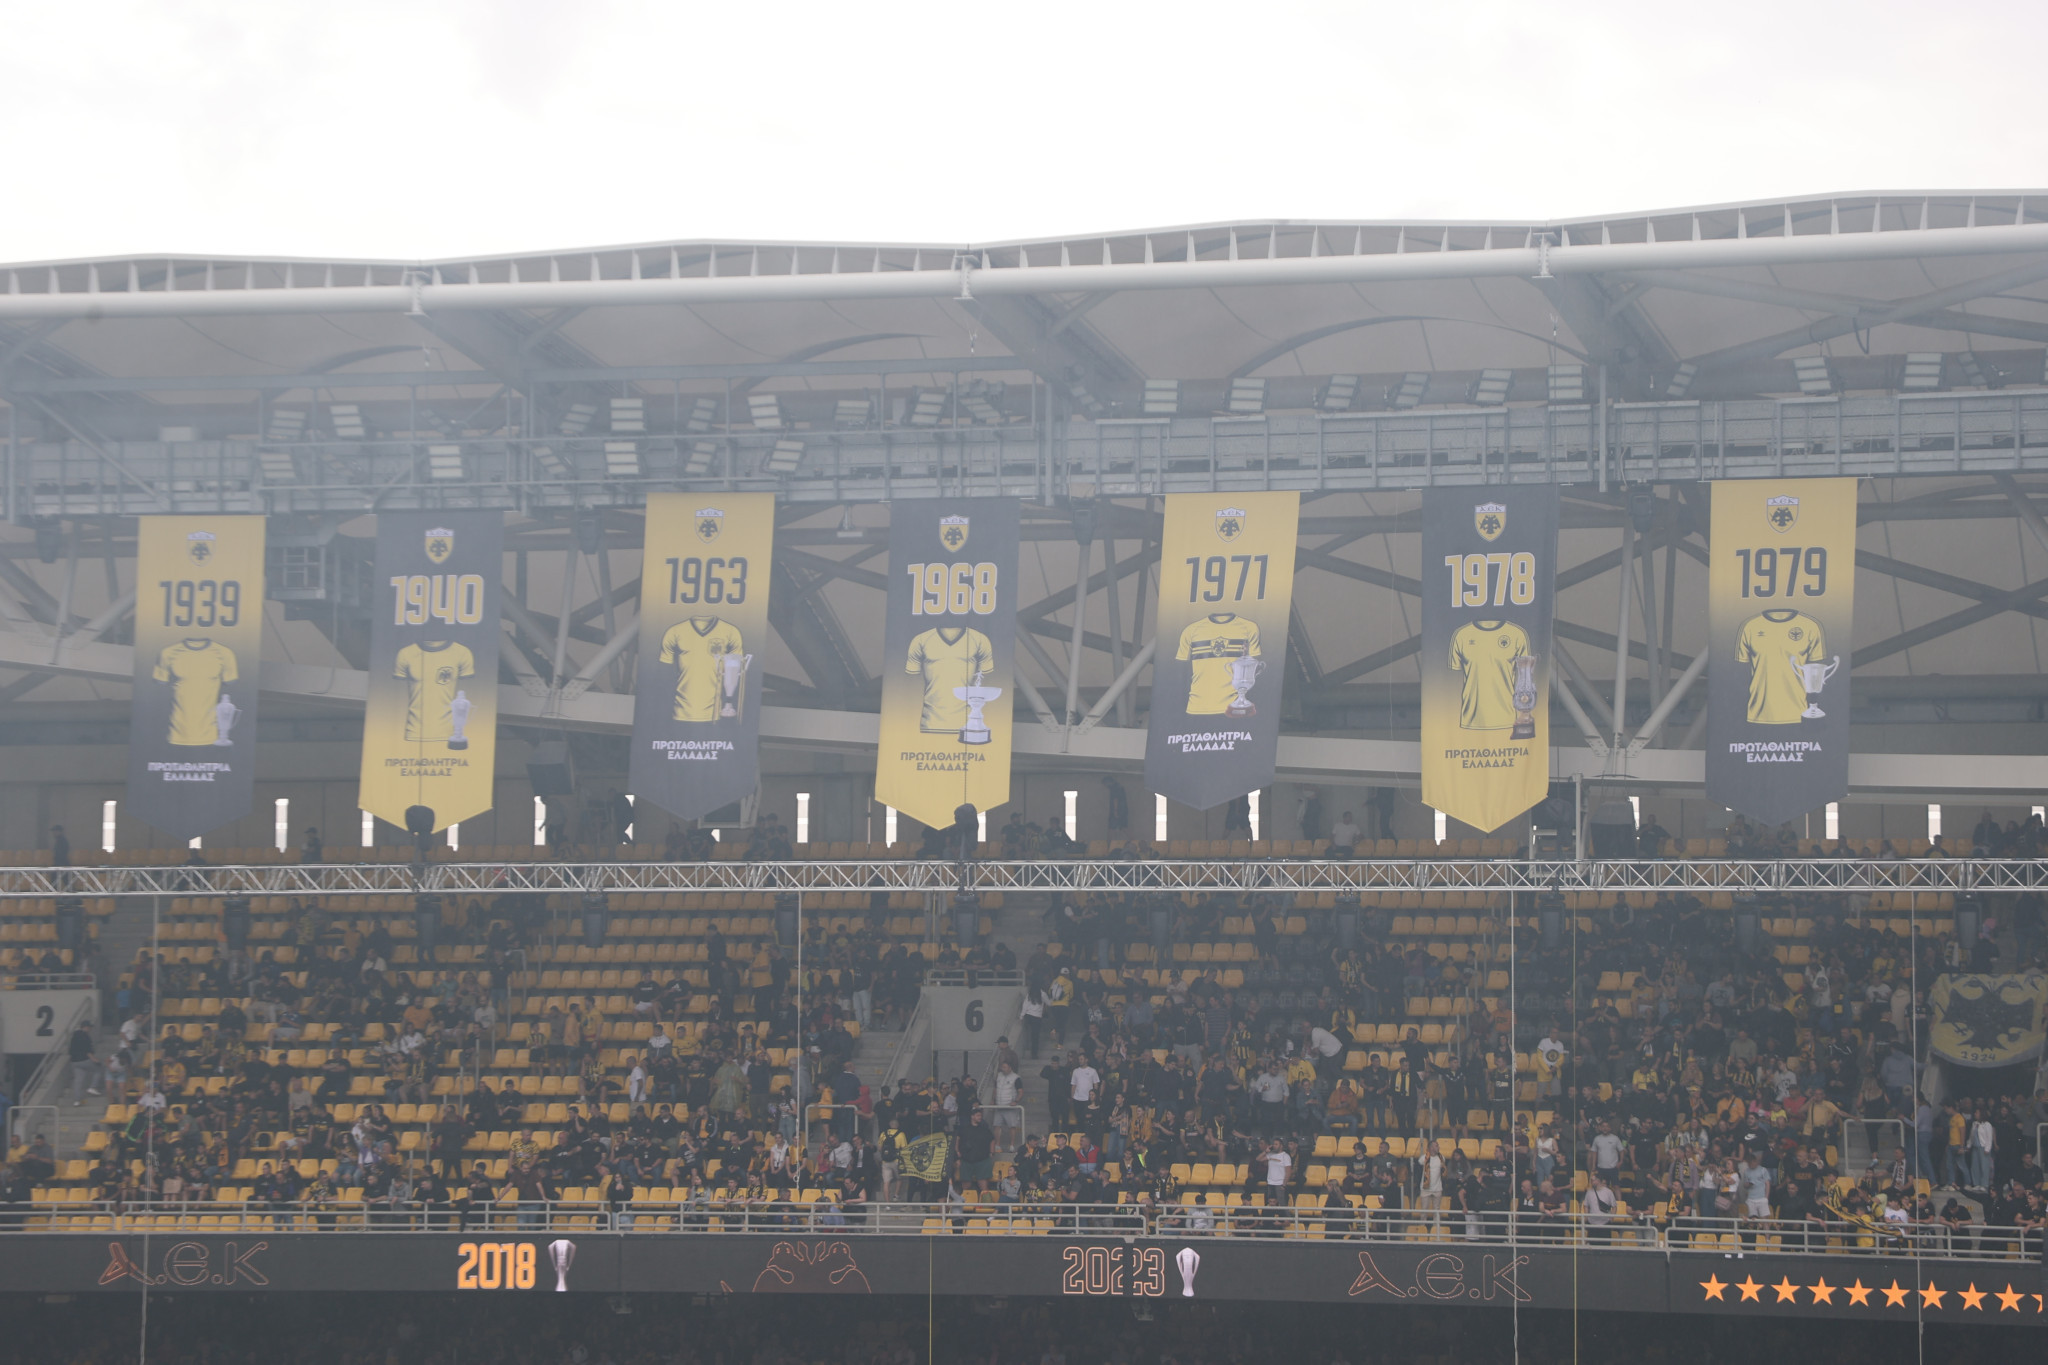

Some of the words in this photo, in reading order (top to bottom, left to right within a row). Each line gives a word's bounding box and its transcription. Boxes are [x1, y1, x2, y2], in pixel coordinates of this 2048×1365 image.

[665, 556, 748, 605] 1963
[1186, 554, 1268, 603] 1971
[1445, 551, 1536, 607] 1978
[1736, 546, 1828, 598] 1979
[158, 580, 241, 627] 1939
[390, 574, 484, 625] 1940
[907, 562, 998, 615] 1968
[652, 740, 734, 750] ΠΡΩΤΑΘΛΗΤΡΙΑ
[1167, 731, 1252, 744] ΠΡΩΤΑΘΛΗΤΡΙΑ
[1182, 741, 1234, 753] ΕΛΛΑΔΑΣ
[1444, 747, 1529, 759] ΠΡΩΤΑΘΛΗΤΡΙΑ
[1729, 741, 1822, 753] ΠΡΩΤΑΘΛΗΤΡΙΑ
[667, 750, 718, 760] ΕΛΛΑΔΑΣ
[900, 752, 986, 762] ΠΡΩΤΑΘΛΗΤΡΙΑ
[916, 762, 968, 772] ΕΛΛΑΔΑΣ
[1462, 758, 1514, 769] ΕΛΛΑΔΑΣ
[1746, 752, 1804, 763] ΕΛΛΑΔΑΣ
[36, 1005, 54, 1037] 2
[965, 999, 984, 1032] 6
[457, 1242, 537, 1289] 2018
[1063, 1246, 1165, 1296] 2023
